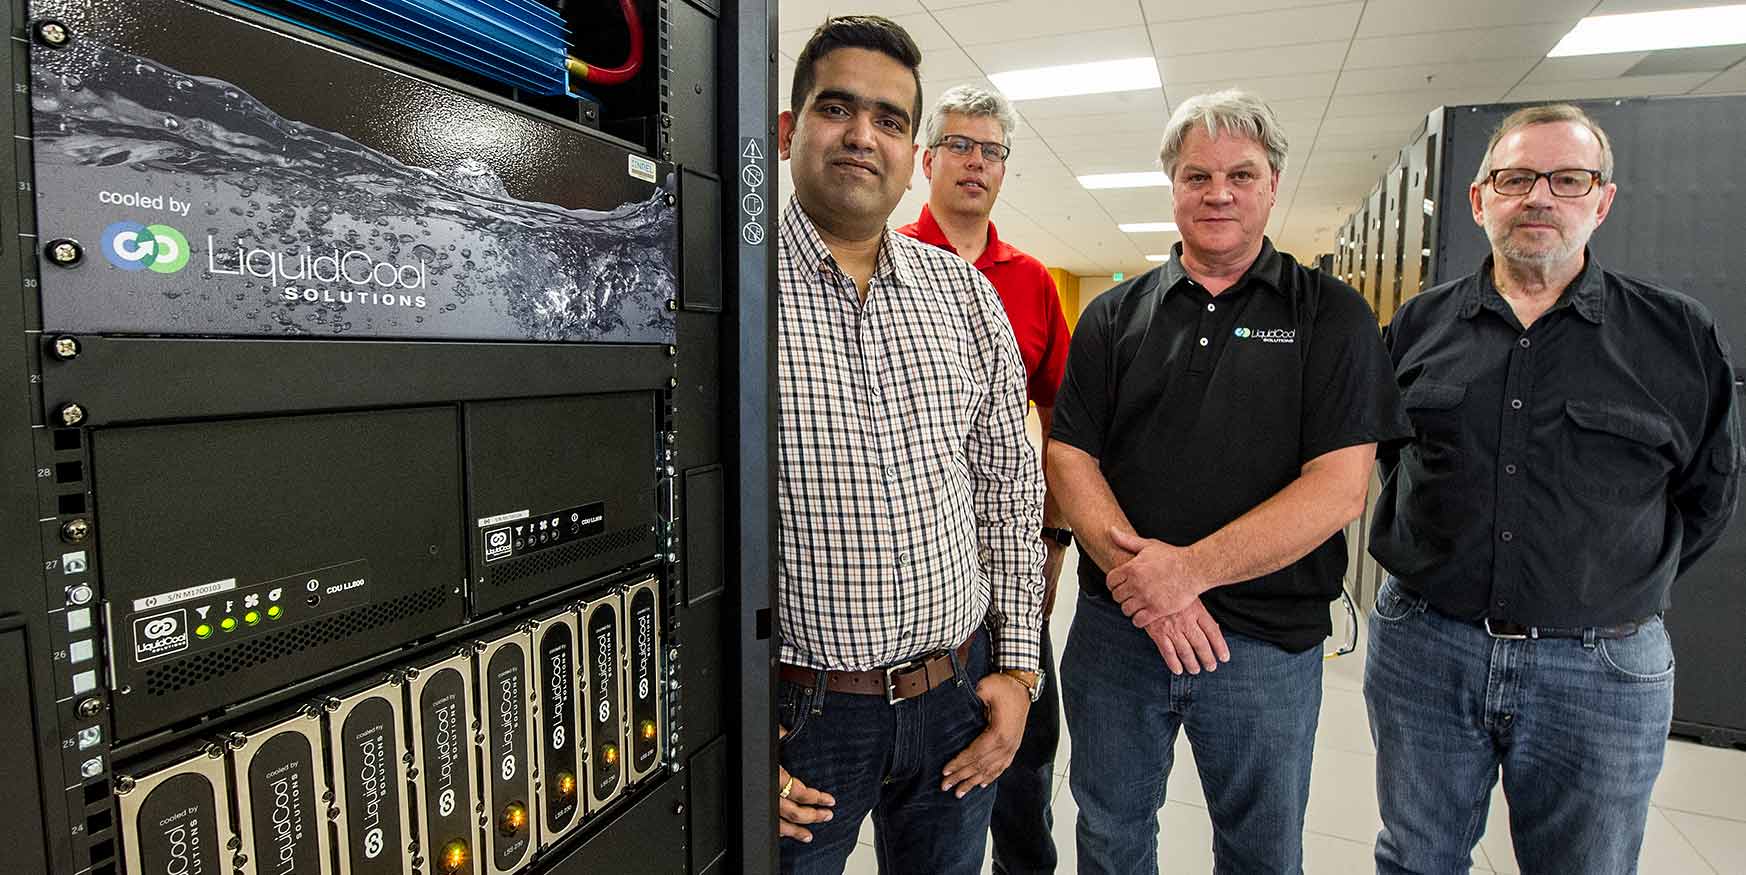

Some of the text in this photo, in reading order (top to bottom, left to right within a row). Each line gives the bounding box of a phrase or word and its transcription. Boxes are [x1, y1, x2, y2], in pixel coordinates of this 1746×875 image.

[99, 190, 191, 216] cooled by
[208, 235, 426, 289] LiquidCool
[23, 278, 38, 288] 30
[284, 286, 426, 308] SOLUTIONS
[1251, 328, 1296, 339] LiquidCool
[37, 468, 51, 478] 28
[45, 560, 58, 570] 27
[53, 650, 67, 660] 26
[137, 632, 187, 653] LiquidCool
[597, 633, 609, 701] LiquidCool
[551, 654, 565, 727] LiquidCool
[500, 678, 515, 756] LiquidCool
[62, 738, 76, 749] 25
[435, 706, 454, 790] LiquidCool
[376, 735, 387, 797] SOLUTIONS
[360, 738, 382, 830] LiquidCool
[159, 805, 199, 826] cooled by
[290, 772, 304, 840] SOLUTIONS
[71, 824, 84, 835] 24
[270, 777, 298, 875] LiquidCool
[190, 819, 203, 875] LUTIONS
